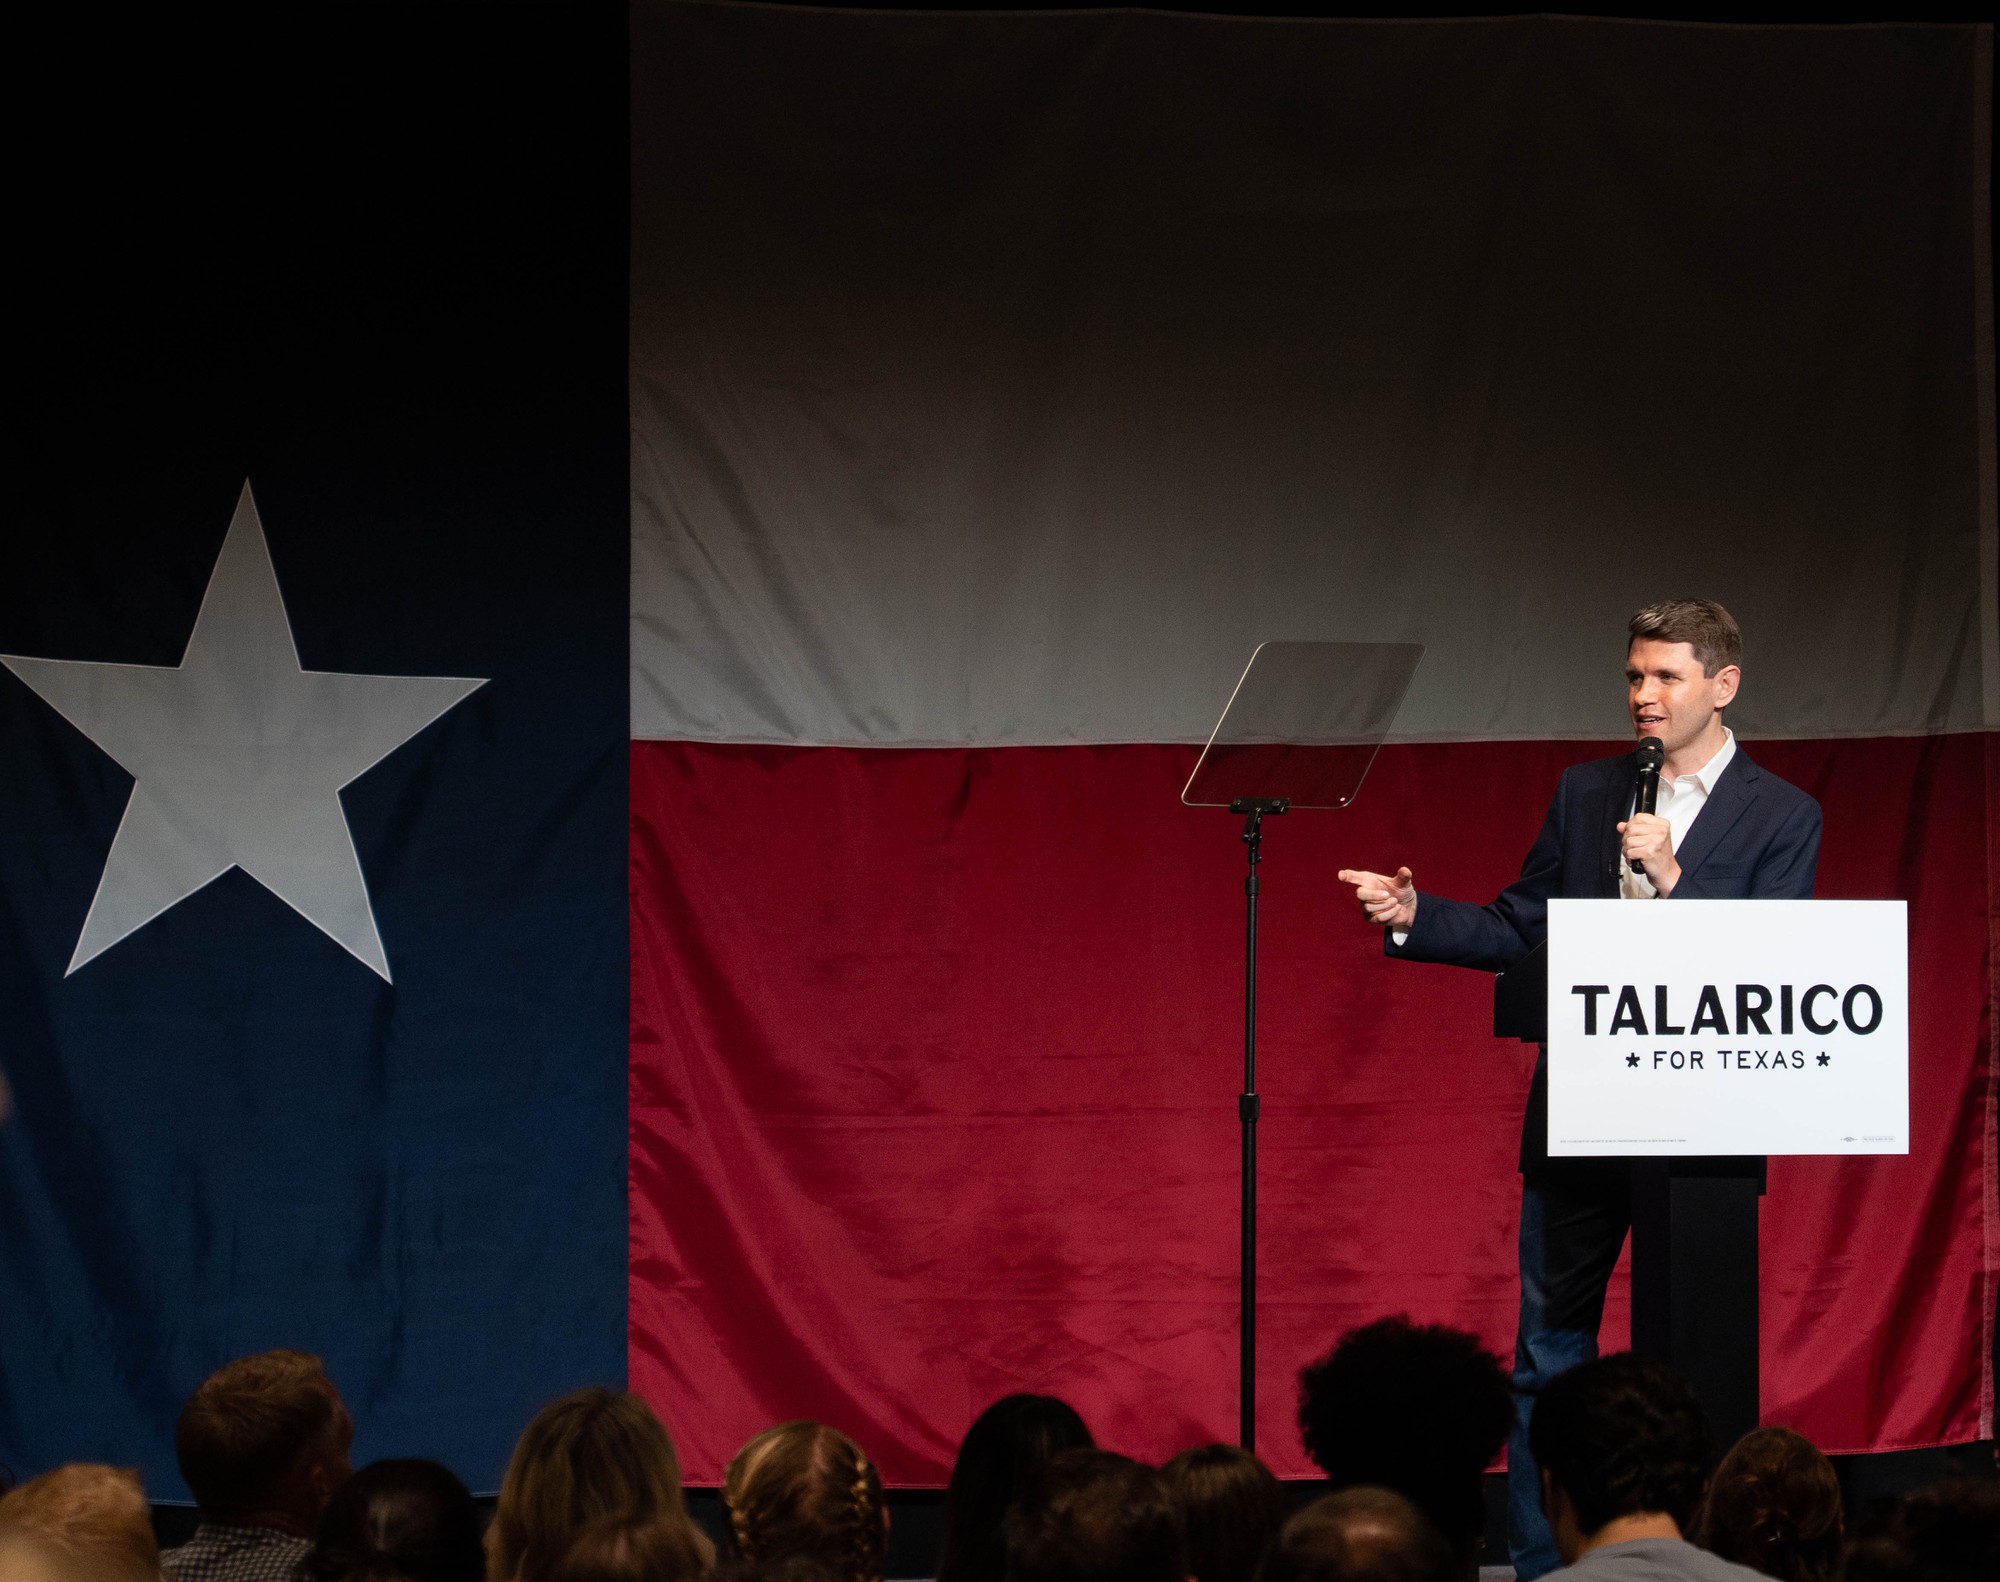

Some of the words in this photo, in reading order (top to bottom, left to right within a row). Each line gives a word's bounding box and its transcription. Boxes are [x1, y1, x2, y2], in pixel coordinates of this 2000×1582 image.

[1571, 984, 1883, 1035] TALARICO
[1653, 1050, 1704, 1070] FOR
[1717, 1050, 1805, 1070] TEXAS
